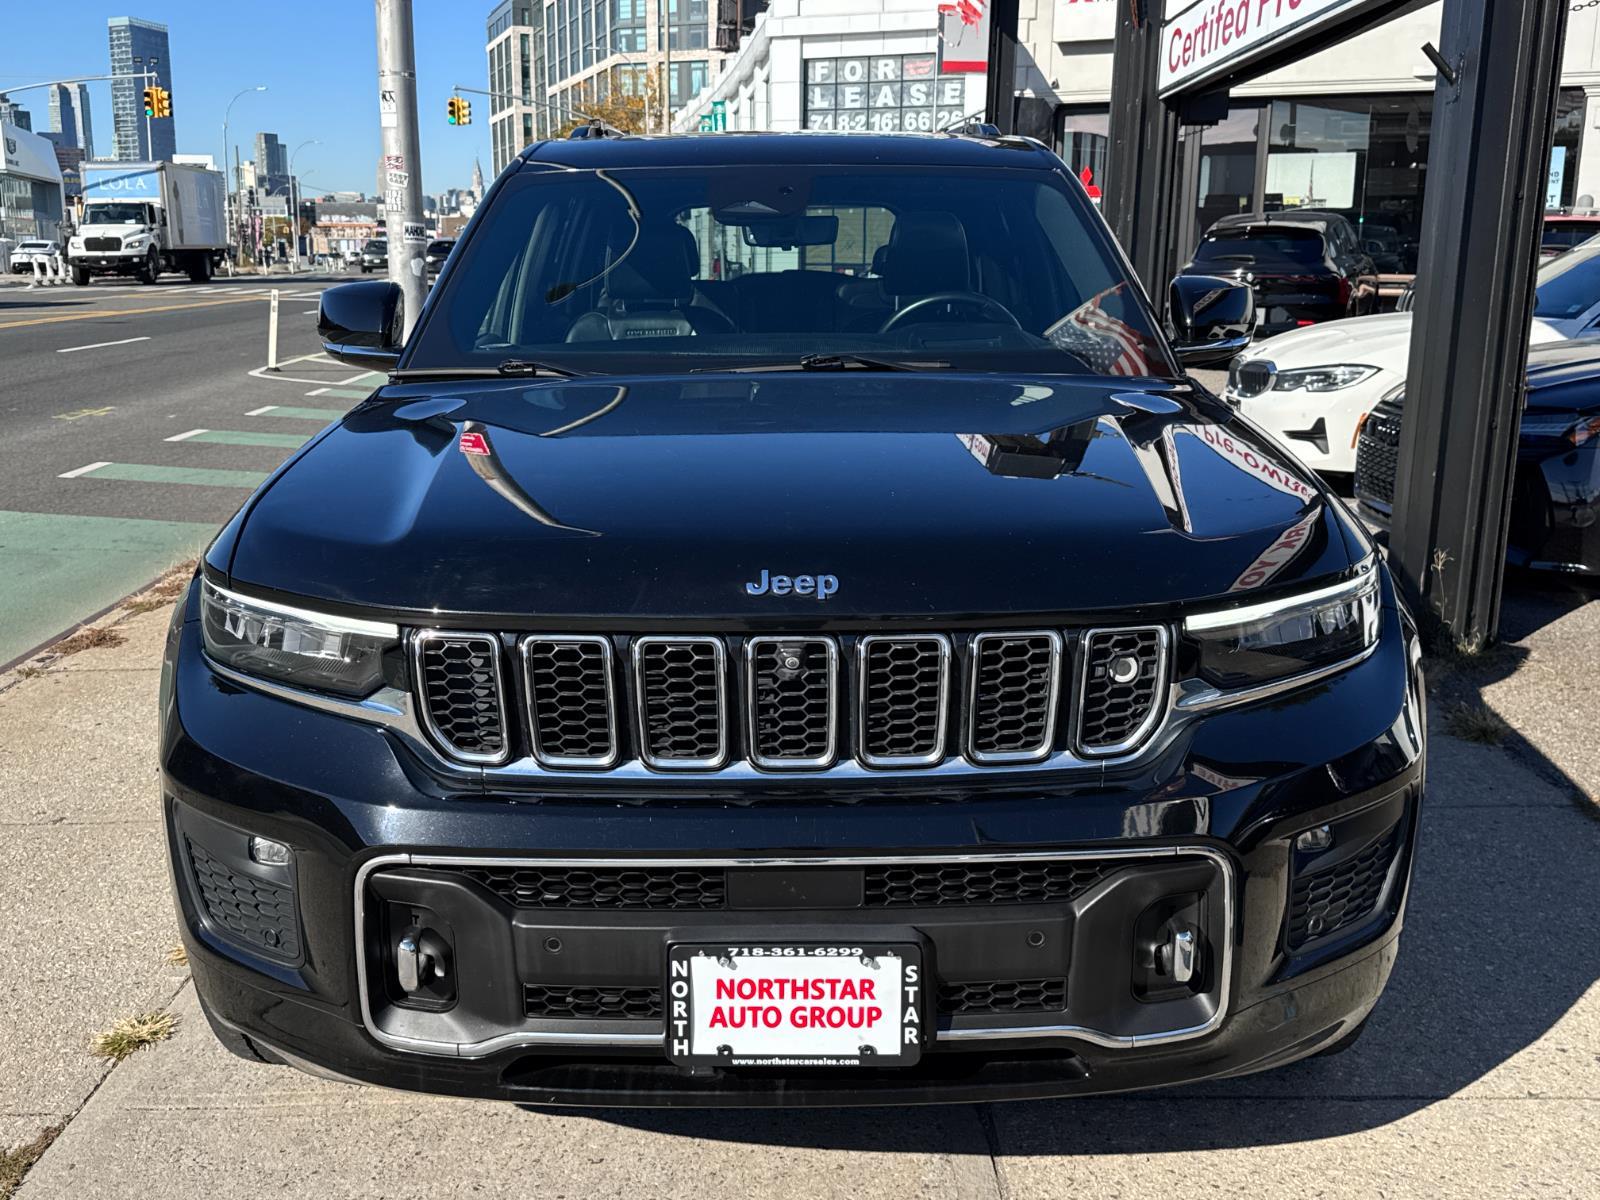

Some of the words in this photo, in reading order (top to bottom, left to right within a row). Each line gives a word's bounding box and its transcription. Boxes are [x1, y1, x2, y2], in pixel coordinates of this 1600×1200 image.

[1168, 0, 1250, 73] Certifed
[814, 59, 896, 83] FOR
[813, 83, 961, 109] LEASE
[98, 176, 147, 191] LOLA
[745, 568, 840, 600] Jeep
[727, 947, 864, 958] 718-361-6299
[716, 978, 877, 1000] NORTHSTAR
[671, 960, 689, 1056] NORTH
[903, 965, 919, 1045] STAR
[708, 1006, 783, 1029] AUTO
[789, 1006, 883, 1029] GROUP
[731, 1057, 860, 1066] www.northstarcarsales.com
